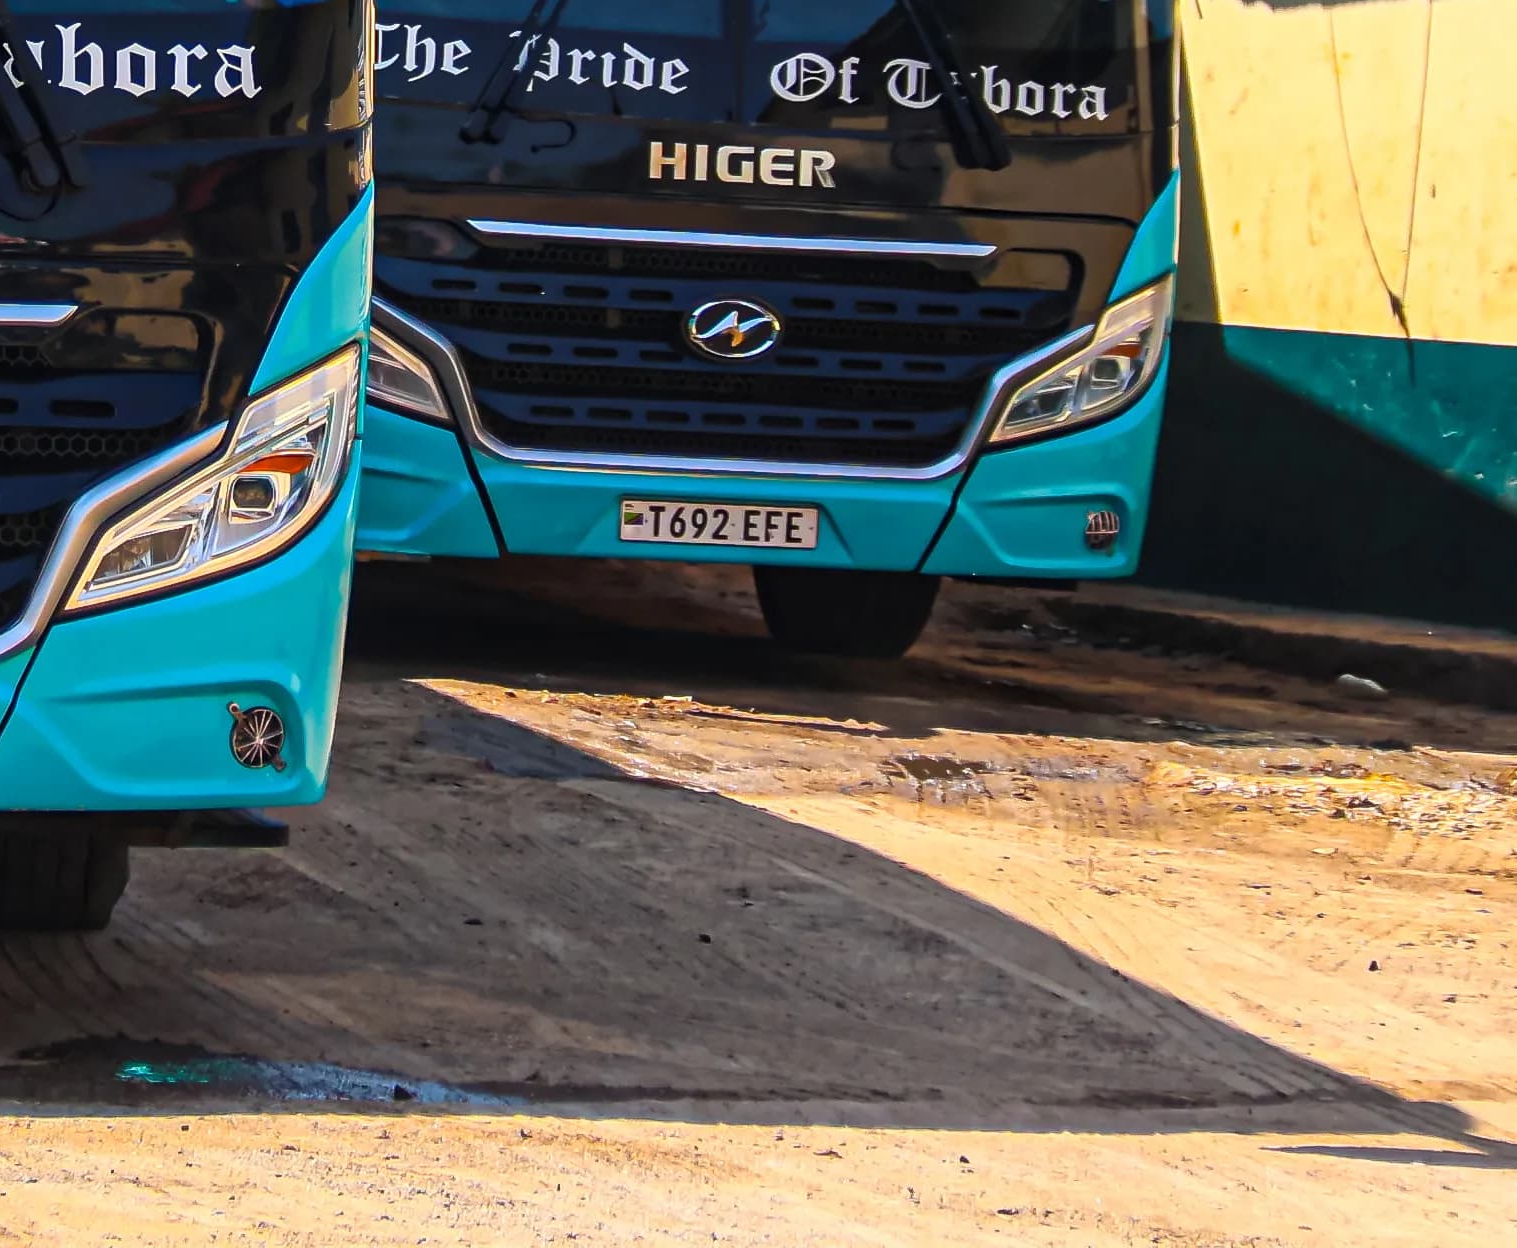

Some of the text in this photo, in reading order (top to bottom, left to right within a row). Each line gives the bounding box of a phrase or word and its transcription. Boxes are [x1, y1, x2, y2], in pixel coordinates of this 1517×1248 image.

[770, 53, 860, 105] Of
[883, 58, 1109, 121] Tbora
[648, 141, 836, 189] HIGER
[648, 505, 804, 544] T692 EFE
